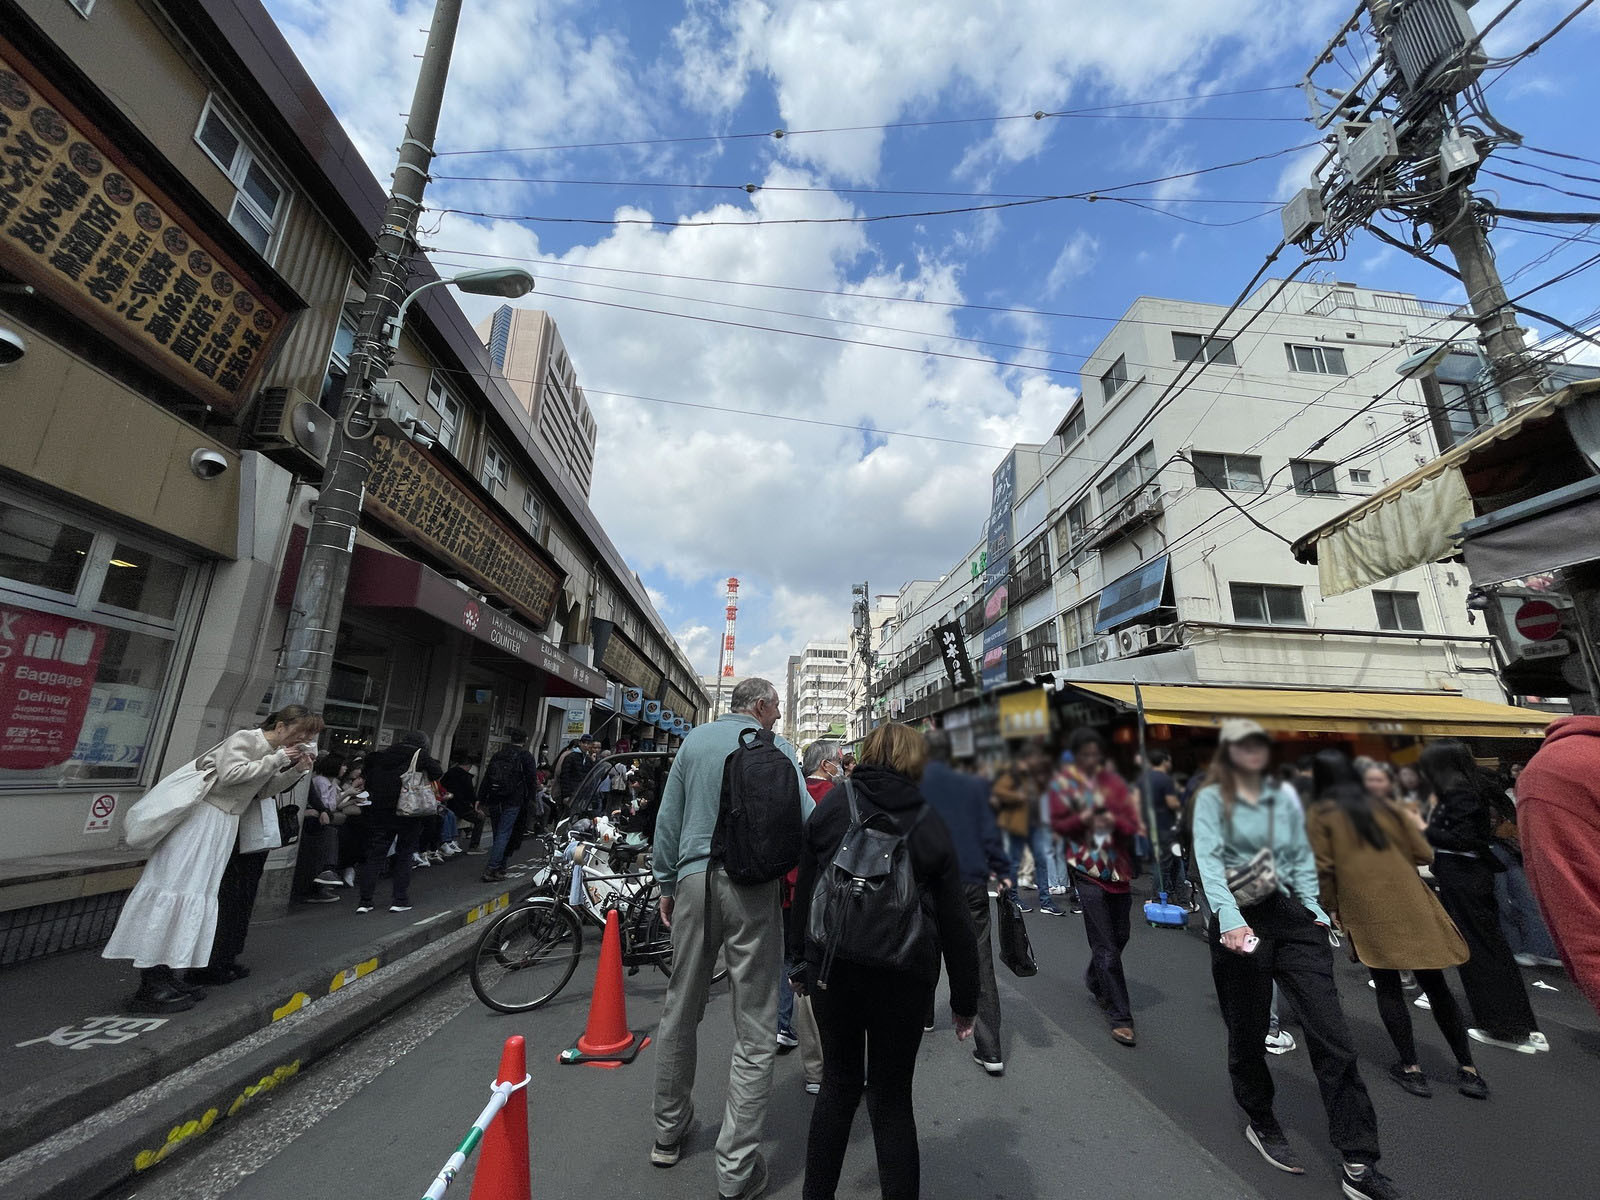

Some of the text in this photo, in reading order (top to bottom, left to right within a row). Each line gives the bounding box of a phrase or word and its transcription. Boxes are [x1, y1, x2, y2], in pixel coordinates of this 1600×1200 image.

[115, 247, 178, 322] 東都グリル
[144, 269, 202, 345] 長生庵
[490, 629, 521, 655] COUNTER
[15, 665, 83, 689] Baggage
[18, 688, 72, 709] Delivery
